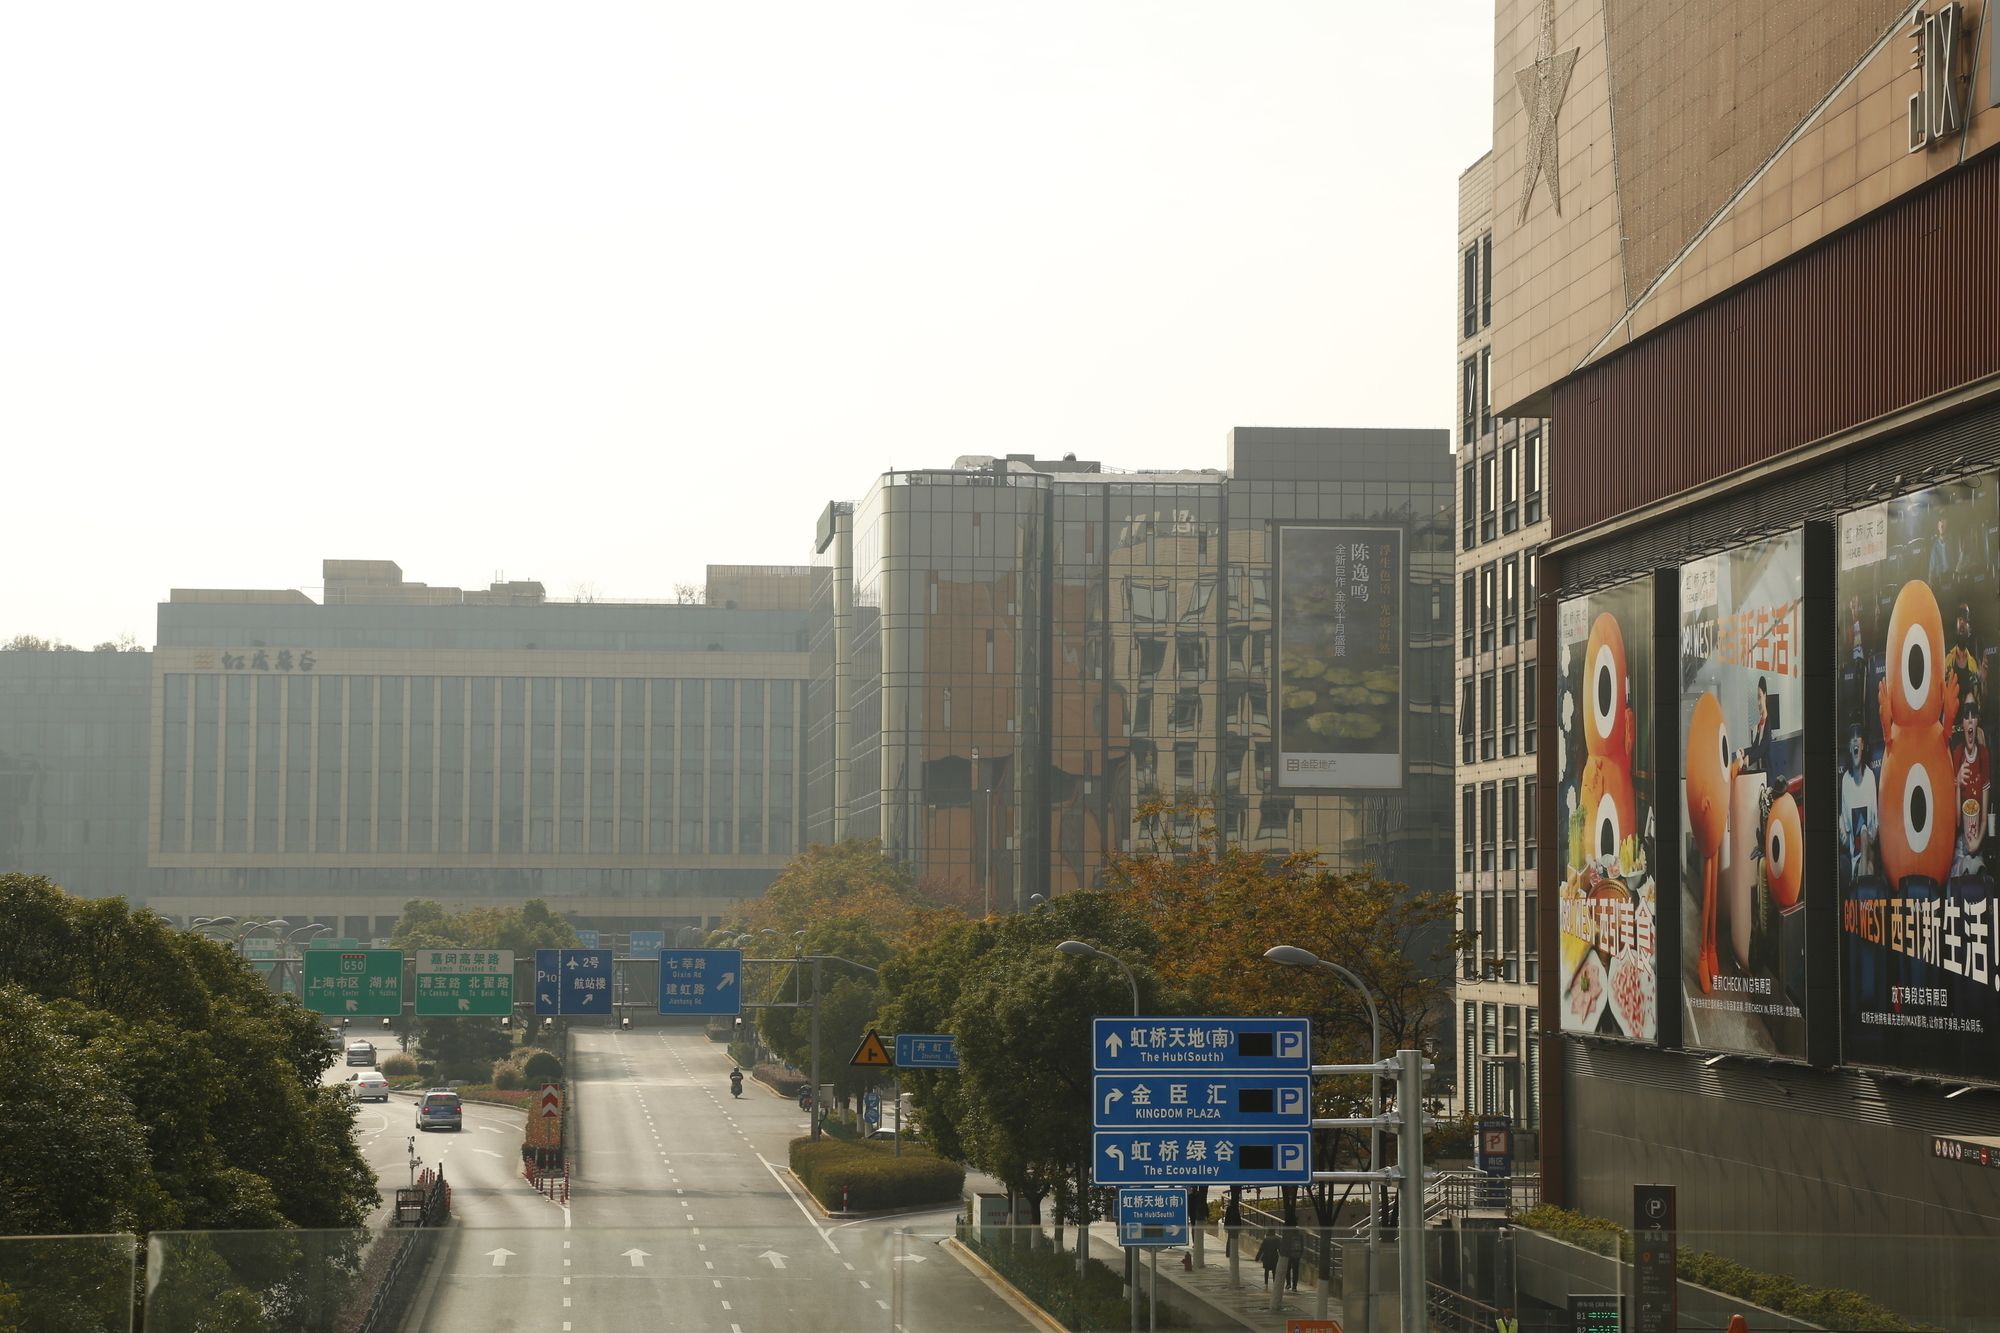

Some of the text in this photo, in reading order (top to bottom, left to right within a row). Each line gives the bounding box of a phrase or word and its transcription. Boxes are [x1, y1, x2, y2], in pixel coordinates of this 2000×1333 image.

[1351, 543, 1370, 602] 陈逸鸣
[1335, 544, 1346, 657] 全新巨作 金秋十月盛展
[1693, 619, 1715, 659] WEST
[1844, 898, 1858, 935] GO!
[1859, 898, 1887, 947] WEST
[1575, 898, 1597, 946] WEST
[1600, 895, 1654, 977] 西引美食
[344, 960, 364, 971] G50
[431, 952, 499, 965] 嘉闵高架路
[582, 956, 600, 969] 2号
[666, 957, 707, 970] 七莘路
[309, 976, 397, 989] 上海市区 湖州
[537, 970, 558, 983] P10
[574, 976, 607, 990] 航站楼
[666, 983, 706, 996] 建虹路
[1891, 985, 1948, 1007] 放下身段总有原因
[1130, 1026, 1235, 1049] 虹桥天地(南)
[1140, 1052, 1225, 1062] The Hub(South)
[1131, 1083, 1227, 1105] 金臣汇
[1135, 1108, 1221, 1119] KINGDOM PLAZA
[1131, 1140, 1235, 1162] 虹桥绿谷
[1143, 1165, 1220, 1177] The Ecovalley
[1122, 1195, 1184, 1209] 虹桥天地(南)
